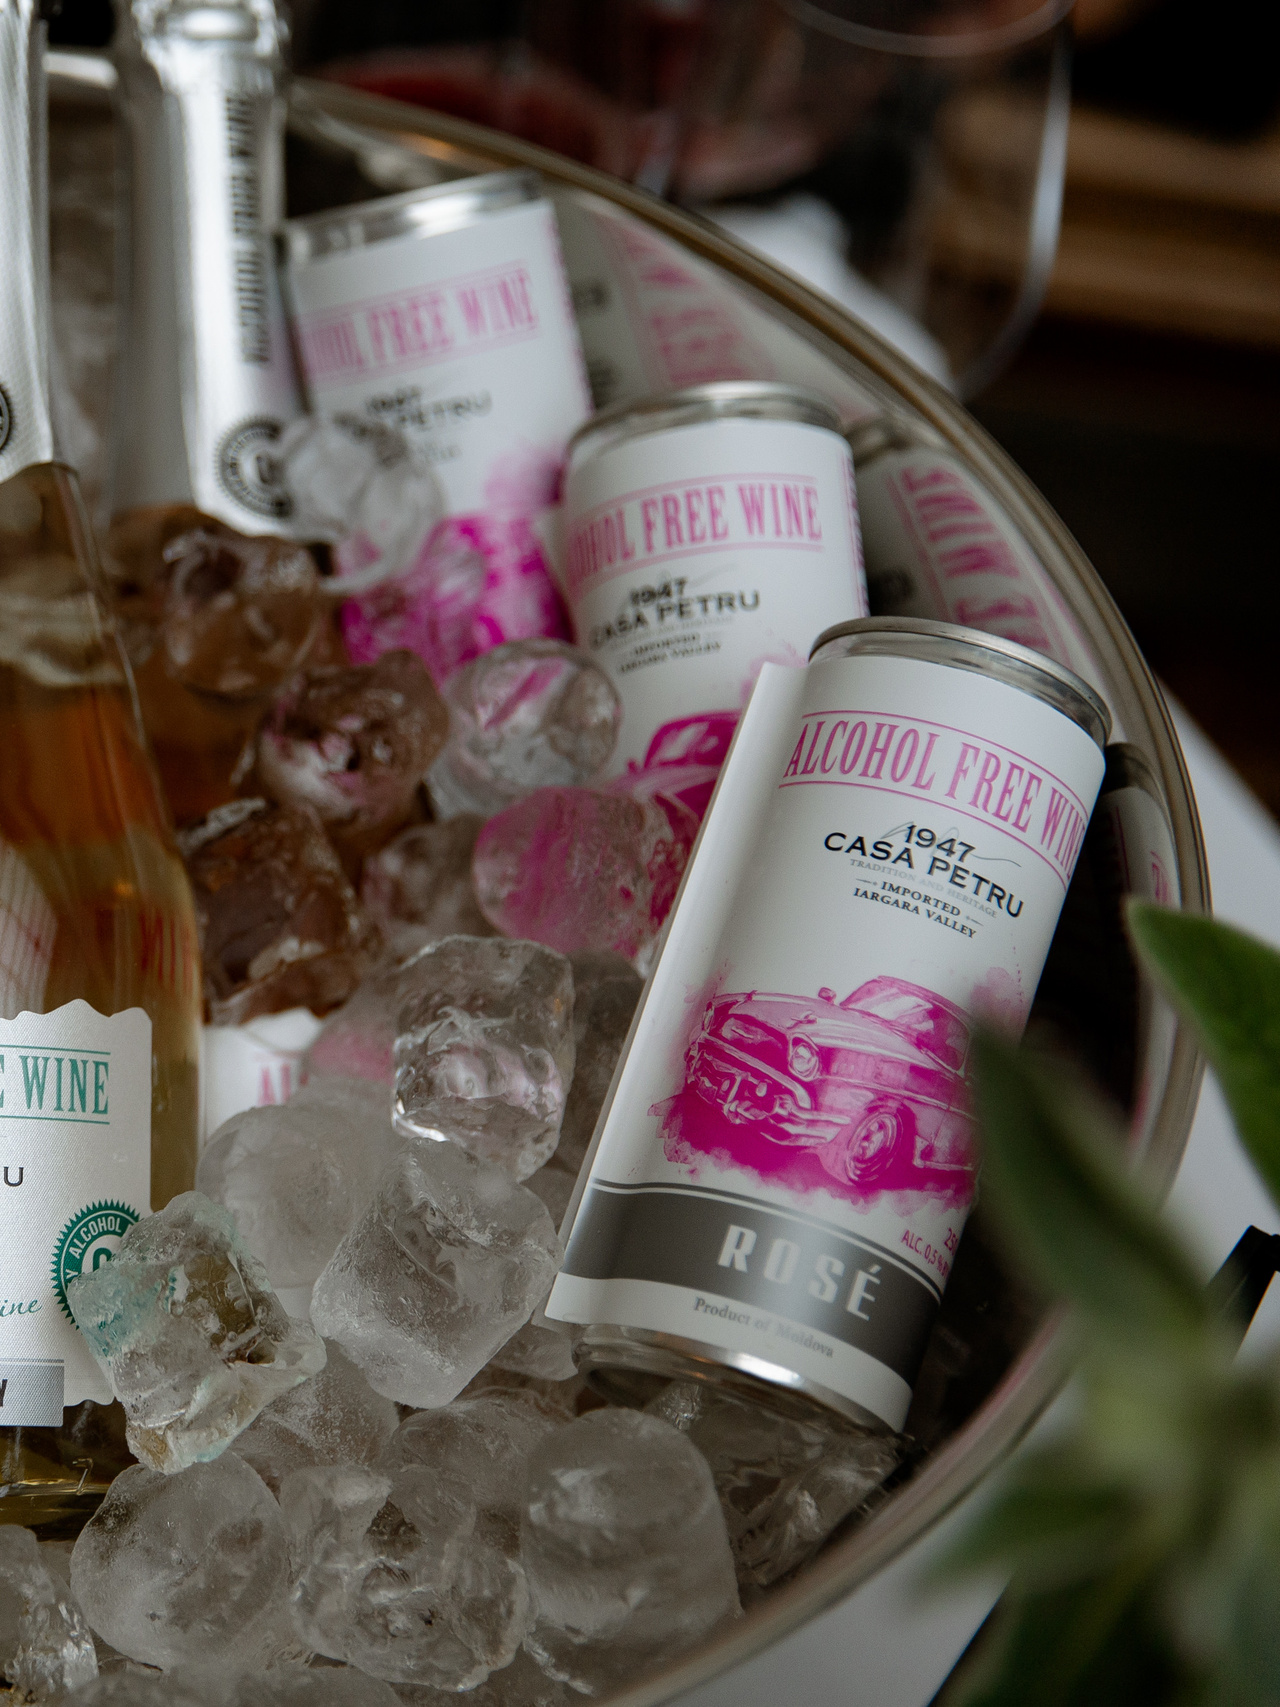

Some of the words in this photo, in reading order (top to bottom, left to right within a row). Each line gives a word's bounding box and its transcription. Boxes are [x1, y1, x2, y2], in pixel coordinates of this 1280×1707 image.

[640, 484, 729, 554] FREE
[737, 483, 823, 540] WINE
[782, 720, 941, 791] ALCOHOL
[944, 742, 1043, 833] FREE
[905, 824, 977, 863] 1947
[823, 832, 915, 869] CASA
[927, 856, 1024, 918] PETRU
[849, 858, 917, 881] TRADITION
[946, 886, 999, 918] HERITAGE
[881, 881, 962, 917] IMPORTED
[853, 887, 921, 915] IARGARA
[926, 909, 977, 939] VALLEY
[19, 1055, 110, 1115] WINE
[68, 1215, 122, 1260] ALCOHOL
[901, 1229, 923, 1257] ALC.
[717, 1224, 882, 1321] ROSÉ
[693, 1296, 752, 1325] Product
